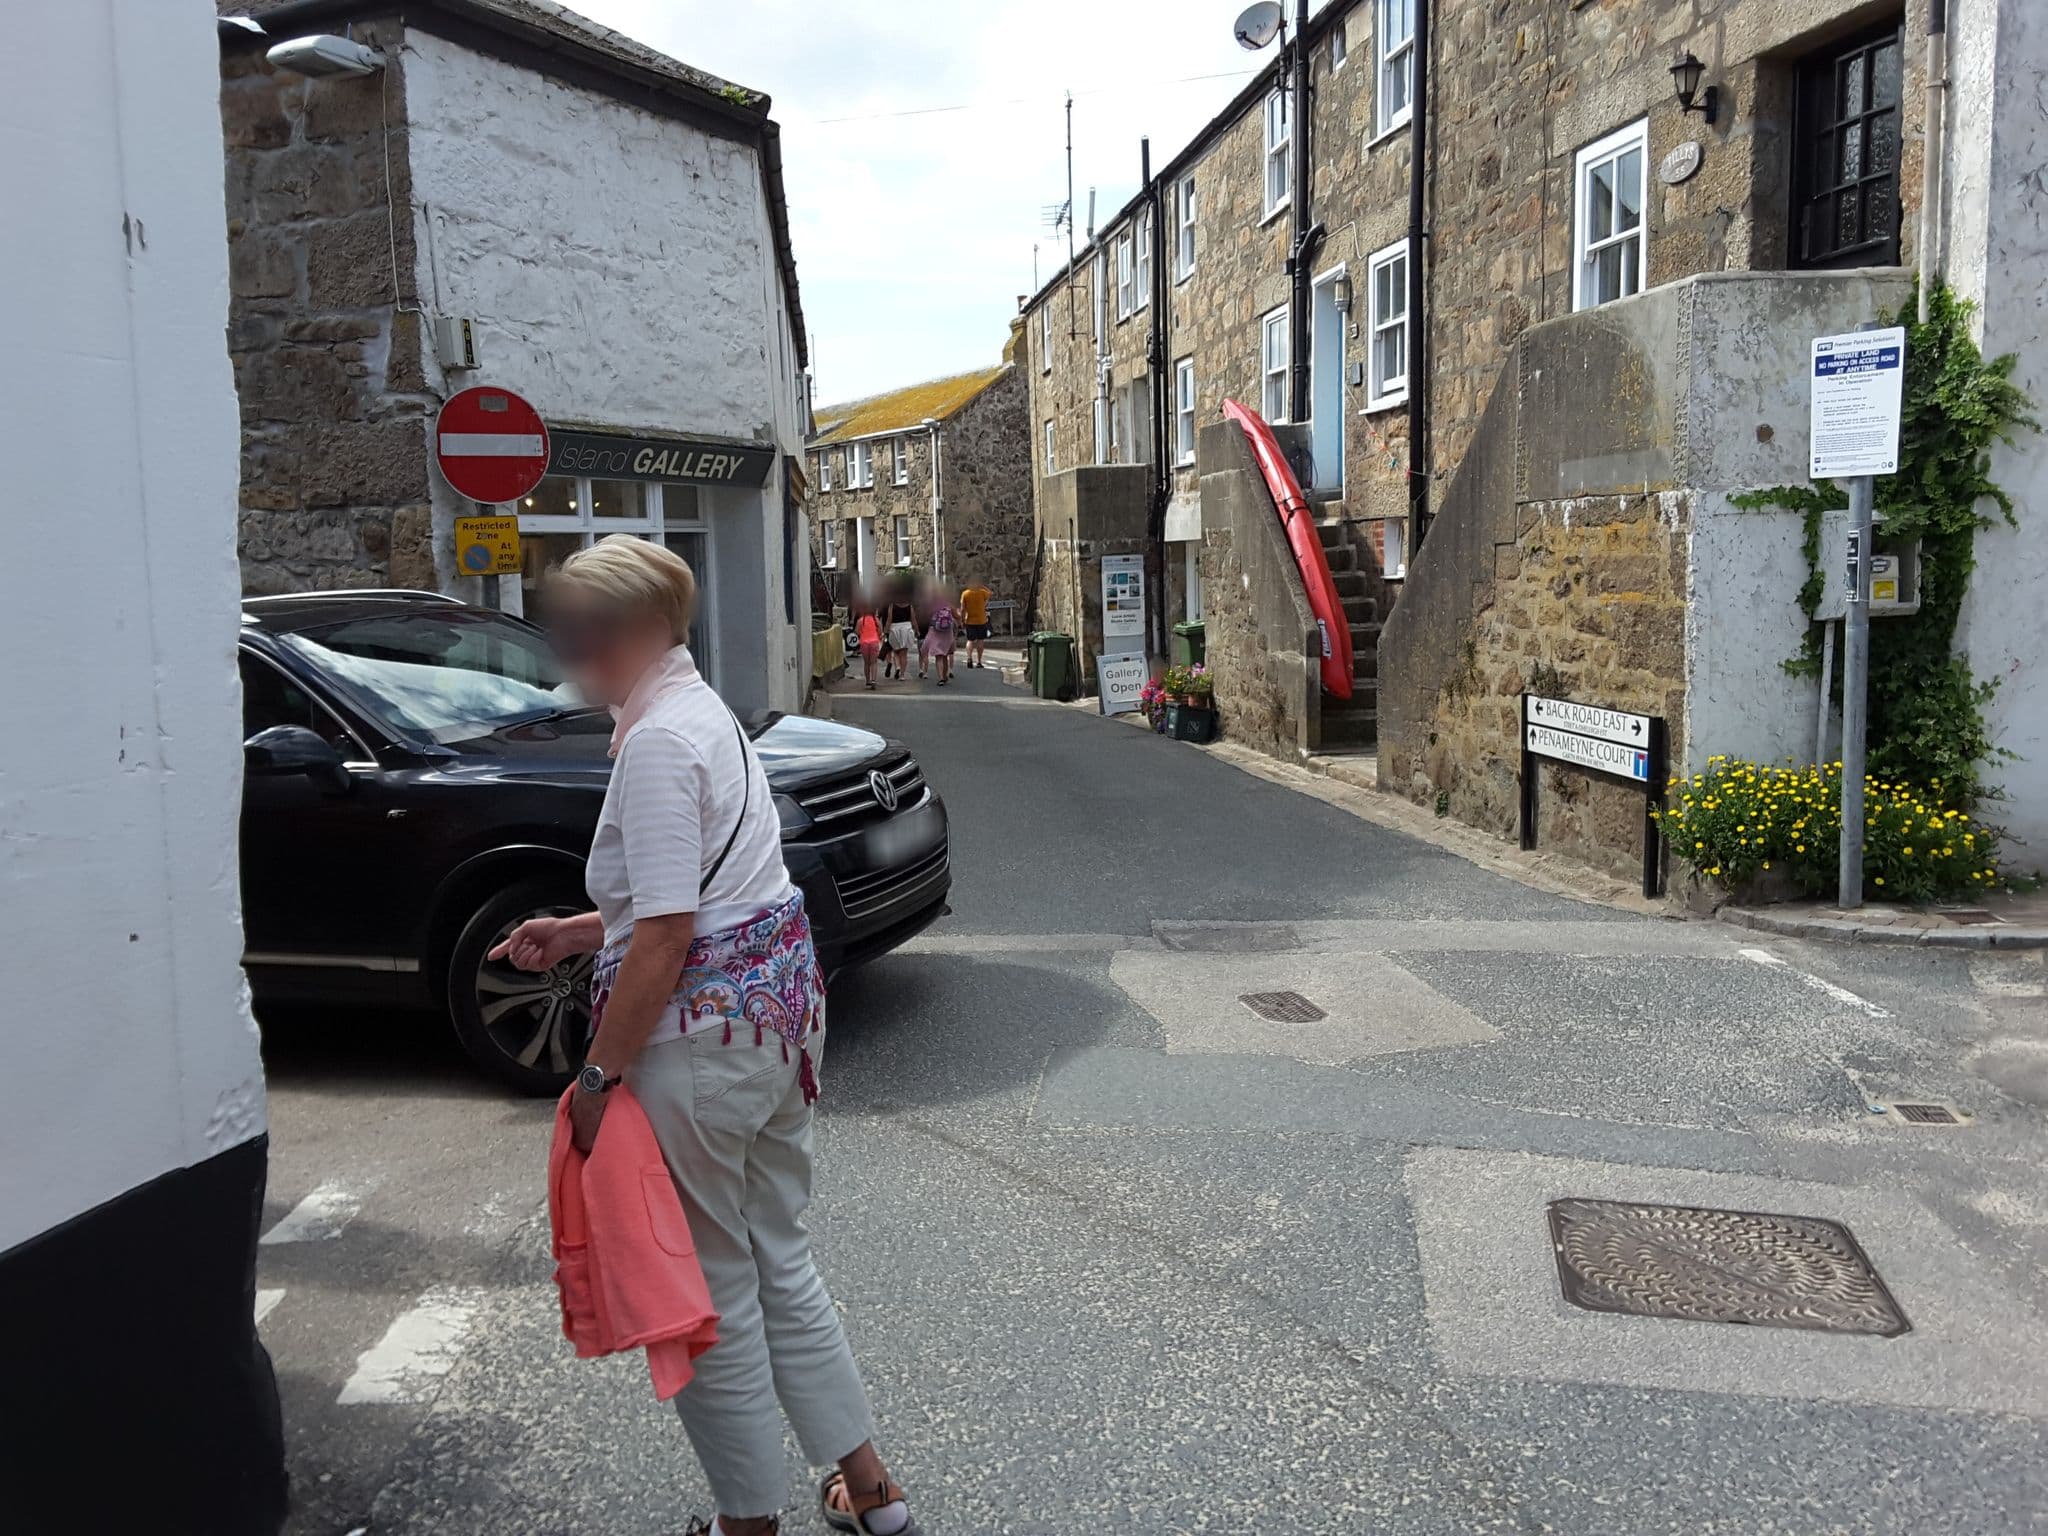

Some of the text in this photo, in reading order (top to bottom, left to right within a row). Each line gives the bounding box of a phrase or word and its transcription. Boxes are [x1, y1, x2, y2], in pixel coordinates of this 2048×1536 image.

[1834, 351, 1859, 360] PRIVATE
[1827, 360, 1849, 368] PARKING
[1859, 356, 1879, 364] ACCESS
[556, 440, 744, 479] Island GALLERY
[463, 522, 511, 530] Restricted
[476, 532, 499, 540] Zne
[501, 542, 512, 550] At
[498, 553, 515, 561] any
[1105, 669, 1143, 679] Gallery
[1111, 683, 1142, 694] Open
[1546, 701, 1570, 720] BACK
[1572, 706, 1601, 726] ROAD
[1603, 711, 1628, 731] EAST
[1538, 729, 1594, 758] PENAMEYNE
[1596, 743, 1633, 767] COURT
